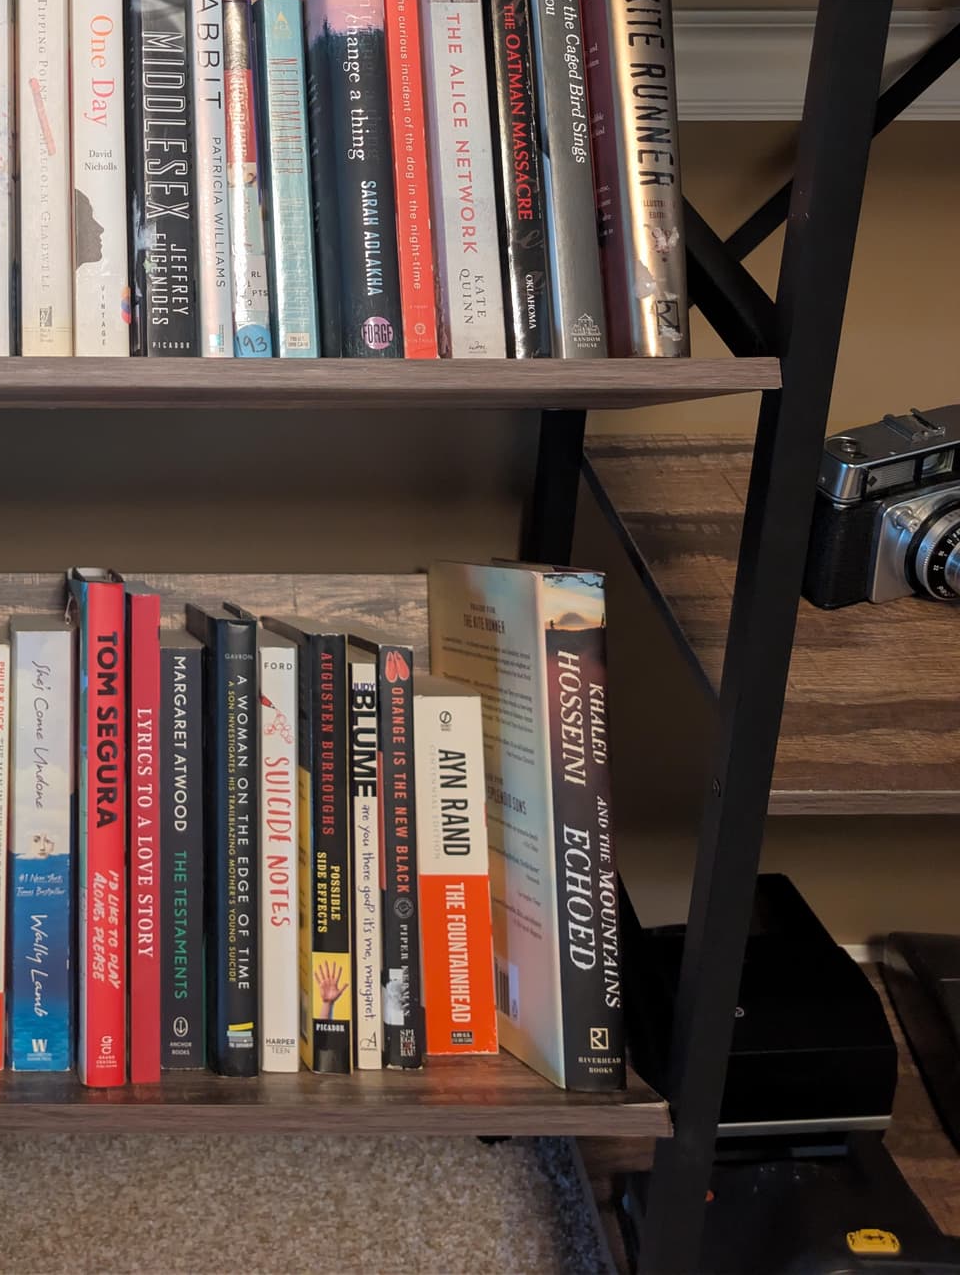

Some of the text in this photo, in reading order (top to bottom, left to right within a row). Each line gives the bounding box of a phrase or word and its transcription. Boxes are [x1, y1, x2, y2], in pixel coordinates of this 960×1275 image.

[84, 15, 114, 125] One Day
[142, 31, 189, 219] MIDDLESEX
[85, 163, 117, 171] Nicholls
[89, 150, 112, 158] David
[212, 137, 225, 288] PATRICIA WILLIAMS
[460, 269, 473, 325] QUINN
[475, 276, 487, 318] KATE
[264, 662, 292, 670] FORD
[557, 650, 586, 785] HOSSEINI
[96, 631, 118, 828] TOM SEGURA
[173, 656, 188, 831] MARGARET ATWOOD
[321, 653, 334, 835] AUGUSTEN BURROUGHS
[352, 692, 376, 798] BLUME
[589, 684, 606, 763] KHALED
[136, 708, 153, 957] LYRICS TO A LOVE STORY
[237, 675, 249, 989] A WOMAN ON THE EDGE OF TIME
[392, 687, 410, 893] ORANGE IS THE NEW BLACK
[438, 749, 470, 856] AYN RAND
[174, 851, 187, 999] THE TESTAMENTS
[331, 865, 340, 921] POSSIBLE
[445, 882, 465, 909] THE
[563, 824, 596, 970] ECHOED
[447, 914, 471, 1022] FOUNTAINHEAD
